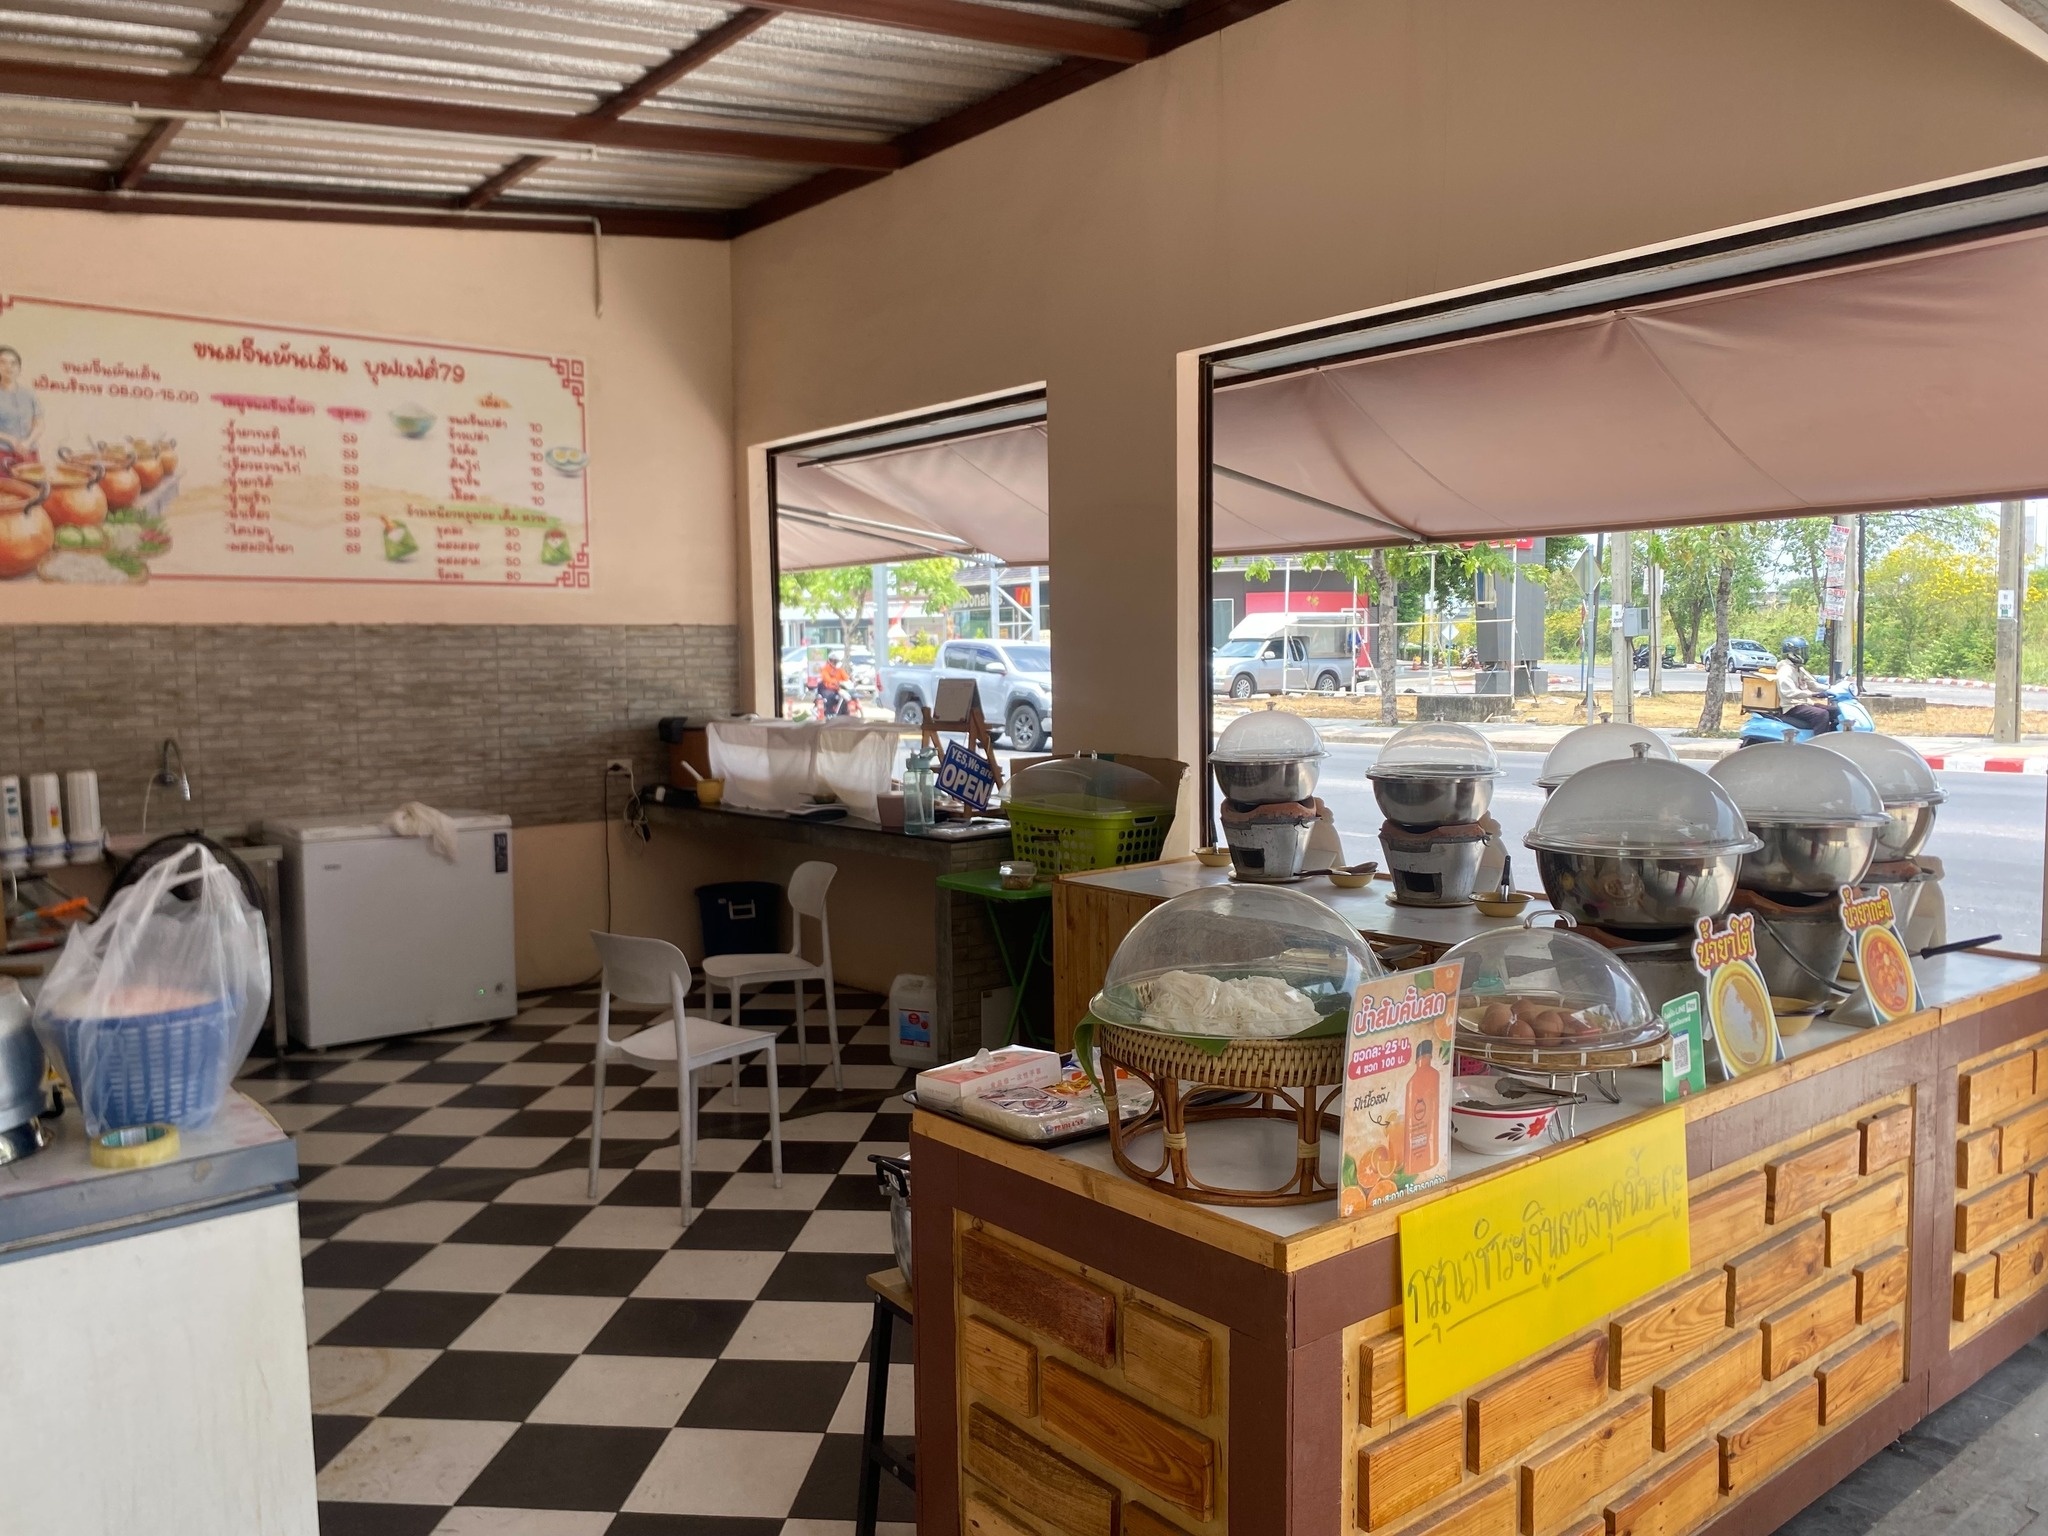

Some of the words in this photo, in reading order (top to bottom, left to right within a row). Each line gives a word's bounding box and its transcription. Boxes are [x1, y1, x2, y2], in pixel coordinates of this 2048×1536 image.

[942, 763, 991, 806] OPEN
[1842, 887, 1895, 930] น้ำยากะทิ
[1696, 914, 1755, 970] น้ำยาใต้
[1353, 985, 1447, 1037] น้ำส้มคั้นสด
[1355, 1066, 1361, 1076] 4
[1381, 1056, 1396, 1069] 100
[1385, 1039, 1398, 1055] 25
